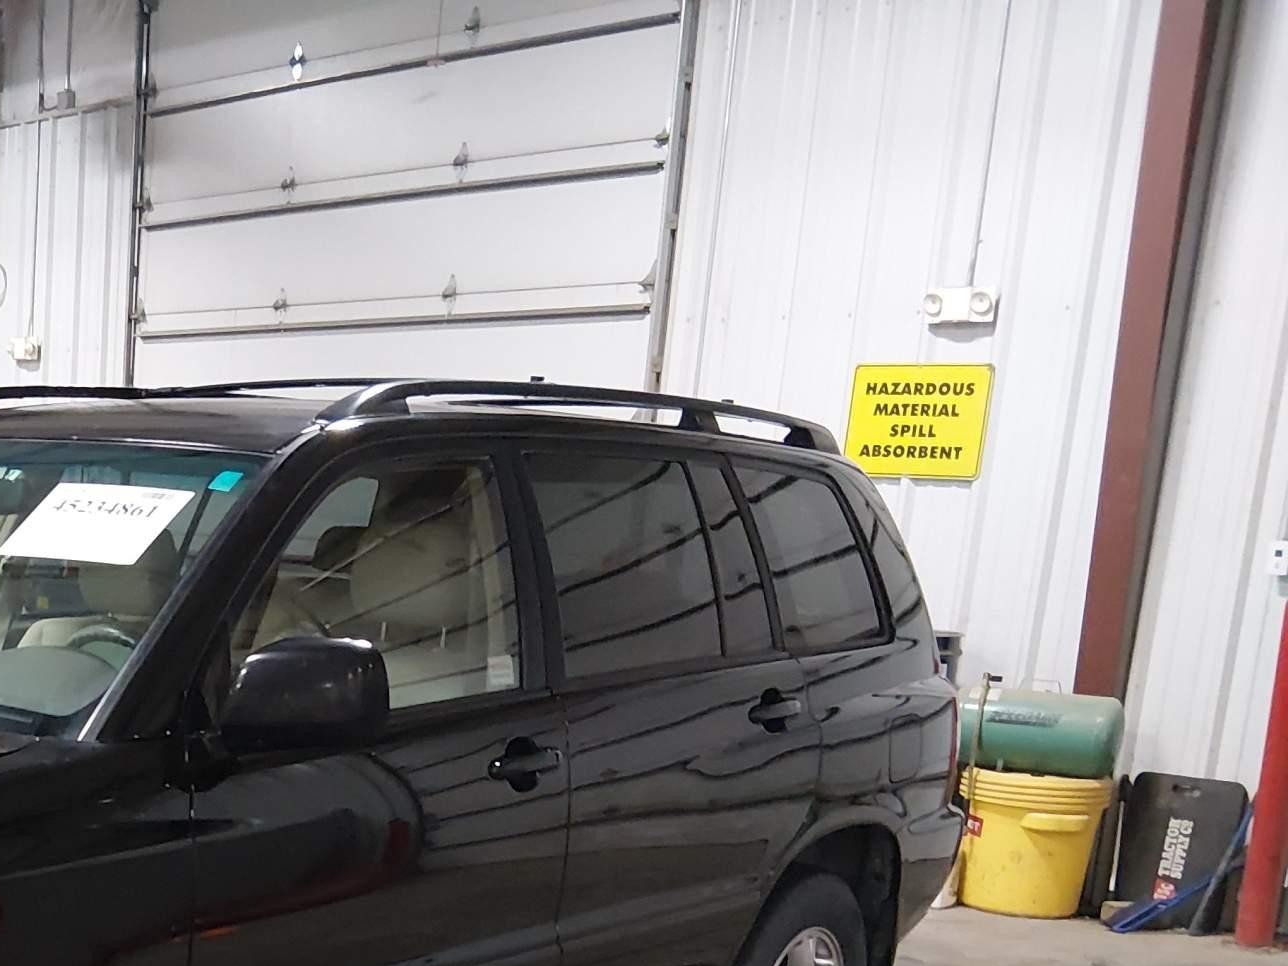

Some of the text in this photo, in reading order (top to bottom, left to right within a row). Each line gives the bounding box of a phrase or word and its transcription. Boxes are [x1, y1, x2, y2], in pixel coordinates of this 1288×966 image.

[866, 382, 975, 396] HAZARDOUS
[873, 403, 960, 417] MATERIAL
[889, 424, 936, 438] SPILL
[859, 444, 963, 460] ABSORBENT
[52, 499, 159, 518] 45234861
[1157, 816, 1181, 877] TRACTOR
[1170, 834, 1190, 880] SUPPLY
